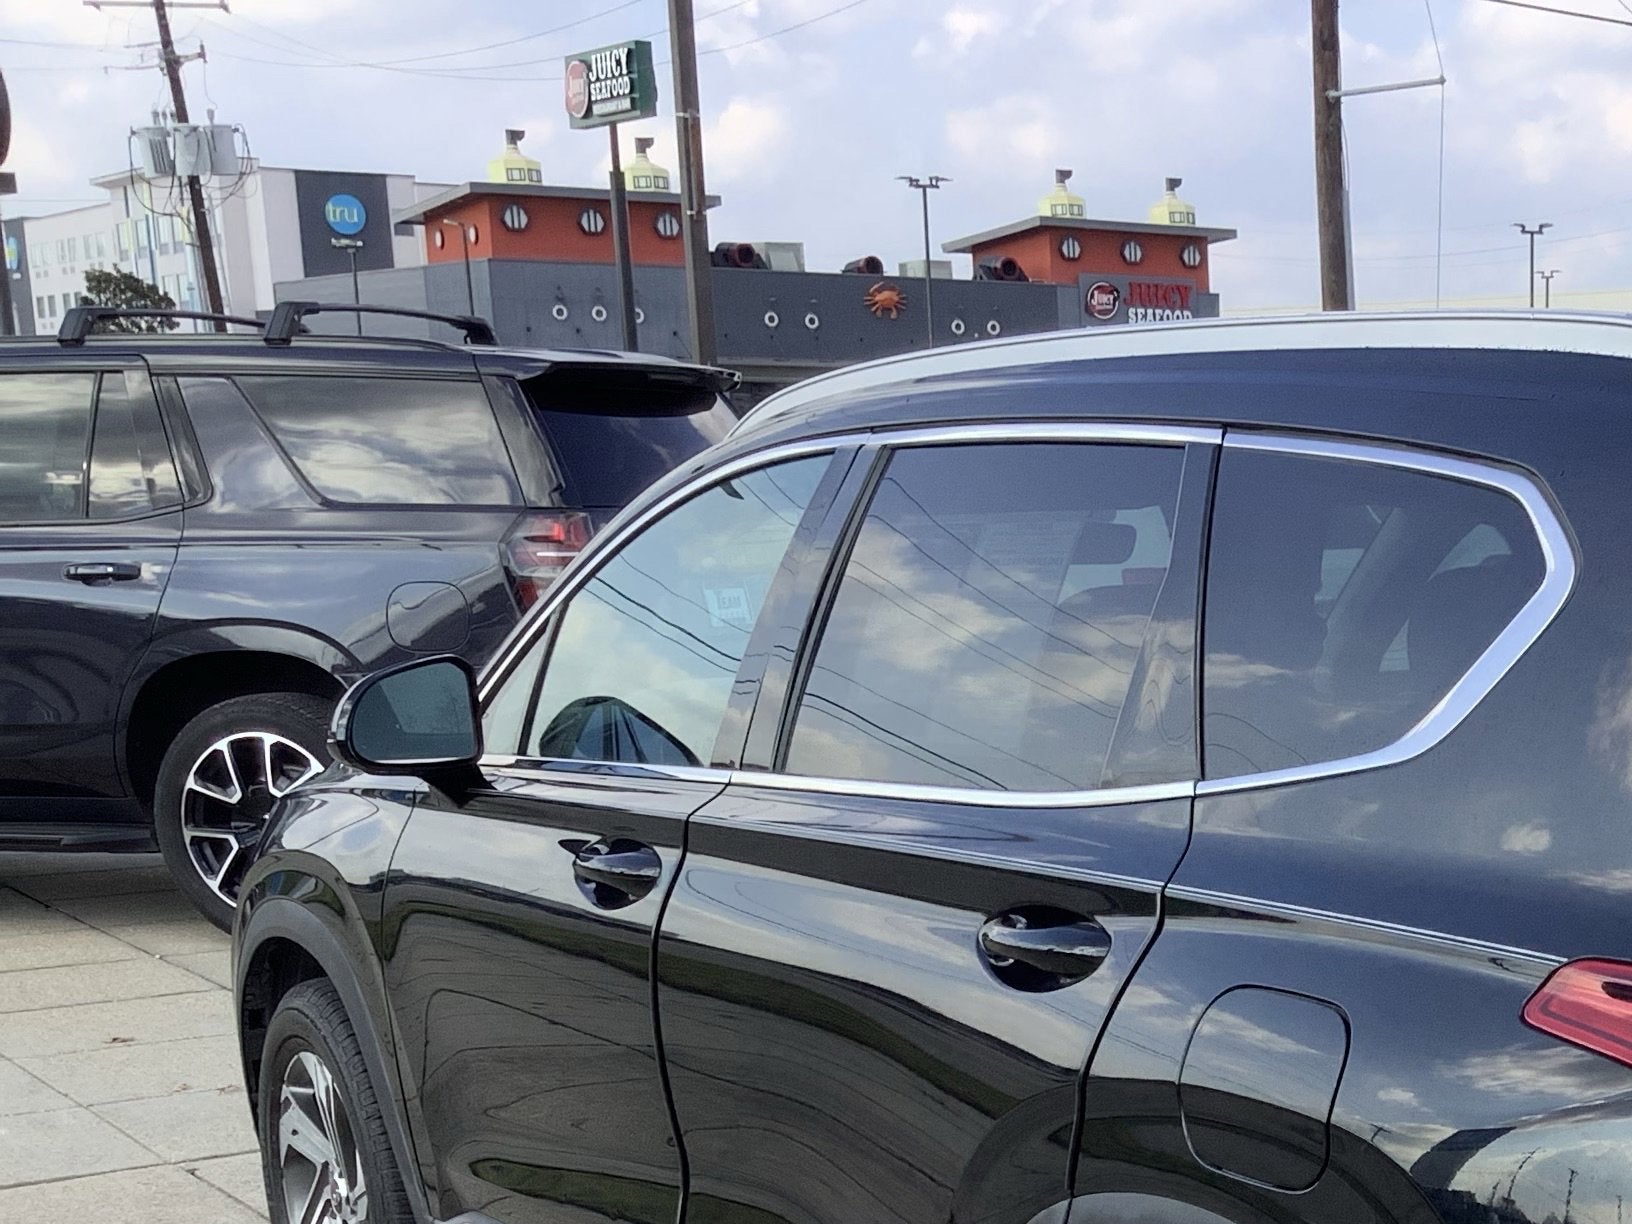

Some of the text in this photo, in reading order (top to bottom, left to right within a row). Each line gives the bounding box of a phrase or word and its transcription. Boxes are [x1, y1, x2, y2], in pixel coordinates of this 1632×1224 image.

[589, 47, 628, 81] JUICY
[590, 76, 630, 100] SEAFOOD
[325, 201, 358, 223] tru
[1124, 282, 1192, 309] JUICY
[1128, 307, 1192, 324] SEAFOOD
